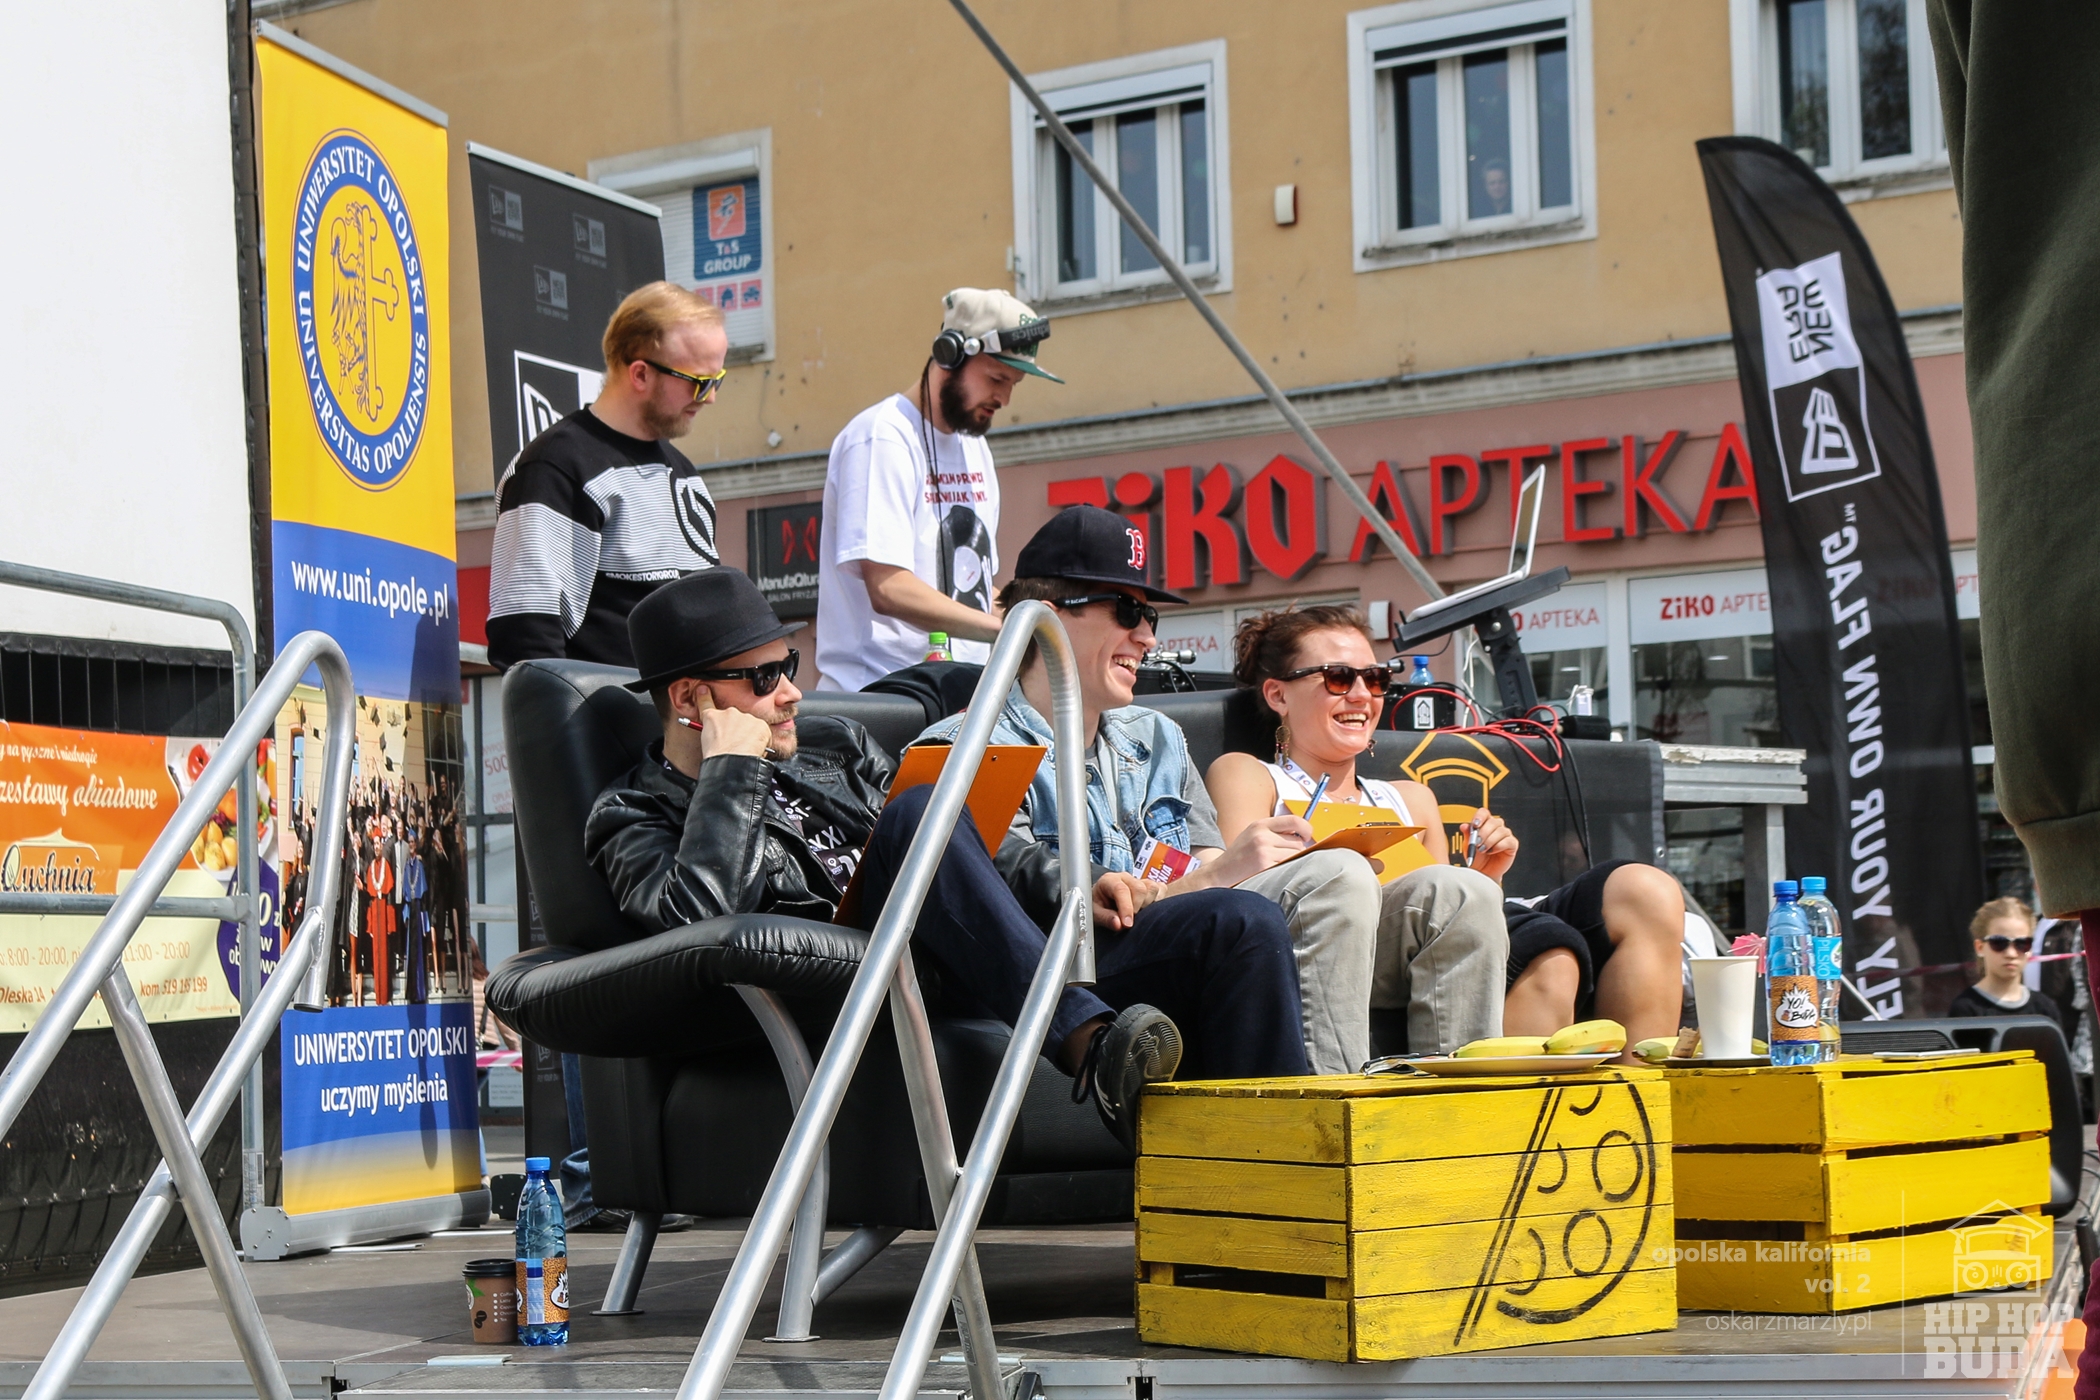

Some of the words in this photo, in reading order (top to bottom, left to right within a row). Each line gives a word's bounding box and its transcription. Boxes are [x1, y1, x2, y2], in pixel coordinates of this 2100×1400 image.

[297, 145, 375, 272] UNIWERSYTET
[378, 174, 424, 315] OPOLSKI
[703, 254, 752, 275] GROUP
[298, 290, 370, 473] UNIVERSITAS
[374, 332, 426, 474] OPOLIENSIS
[1348, 421, 1761, 562] APTEKA
[1126, 528, 1147, 570] B
[291, 560, 449, 626] www.uni.opole.pl
[1720, 591, 1769, 614] APTE
[1528, 607, 1600, 631] APTEKA
[73, 774, 159, 809] obiadowe
[7, 947, 29, 966] 8:00
[161, 941, 190, 960] 20:00
[1816, 939, 1831, 977] PILSKO
[294, 1029, 404, 1066] UNIWERSYTET
[407, 1026, 467, 1059] OPOLSKI
[321, 1084, 380, 1117] uczymy
[384, 1072, 448, 1113] myślenia
